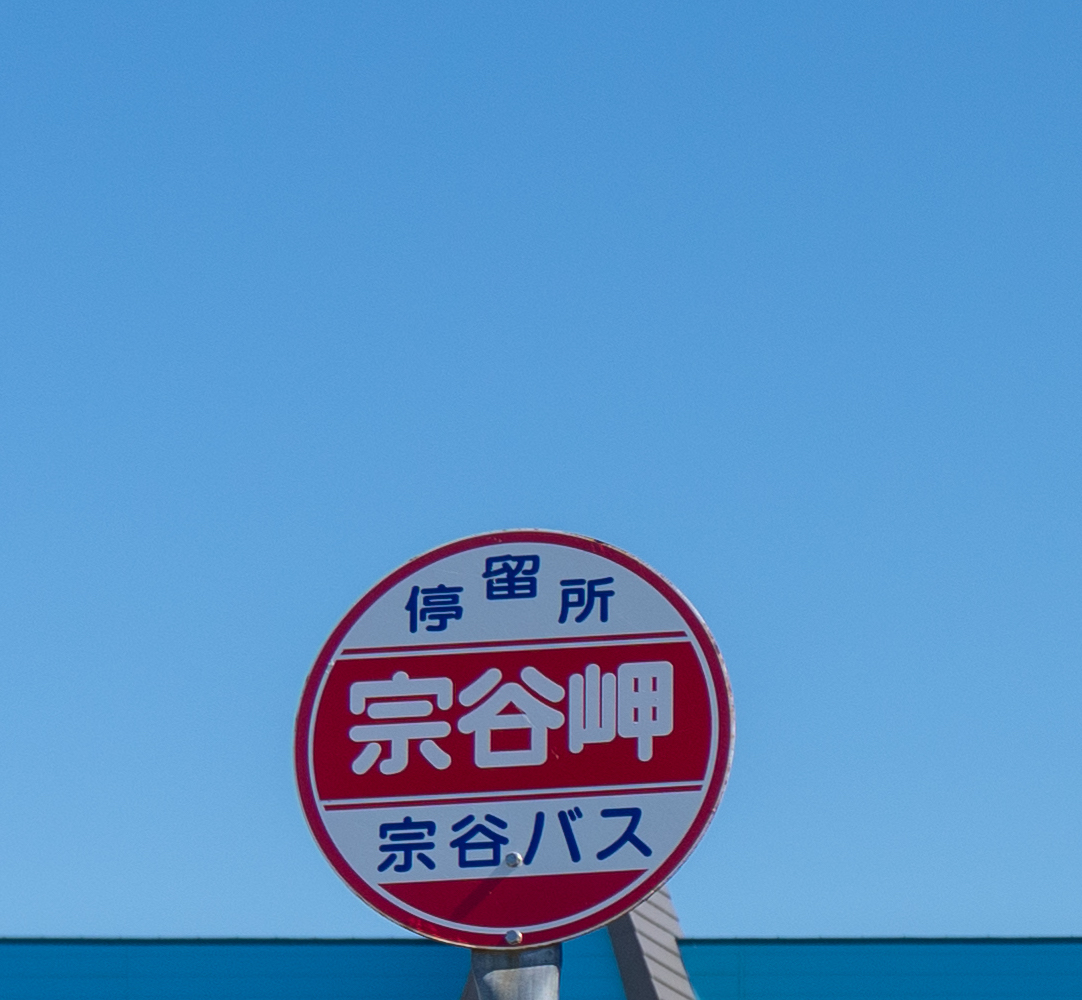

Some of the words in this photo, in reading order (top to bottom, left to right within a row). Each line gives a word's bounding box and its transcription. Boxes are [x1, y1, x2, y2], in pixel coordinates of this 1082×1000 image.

[405, 554, 616, 634] 停留所
[349, 660, 674, 775] 宗谷岬
[376, 806, 653, 873] 宗谷バス
